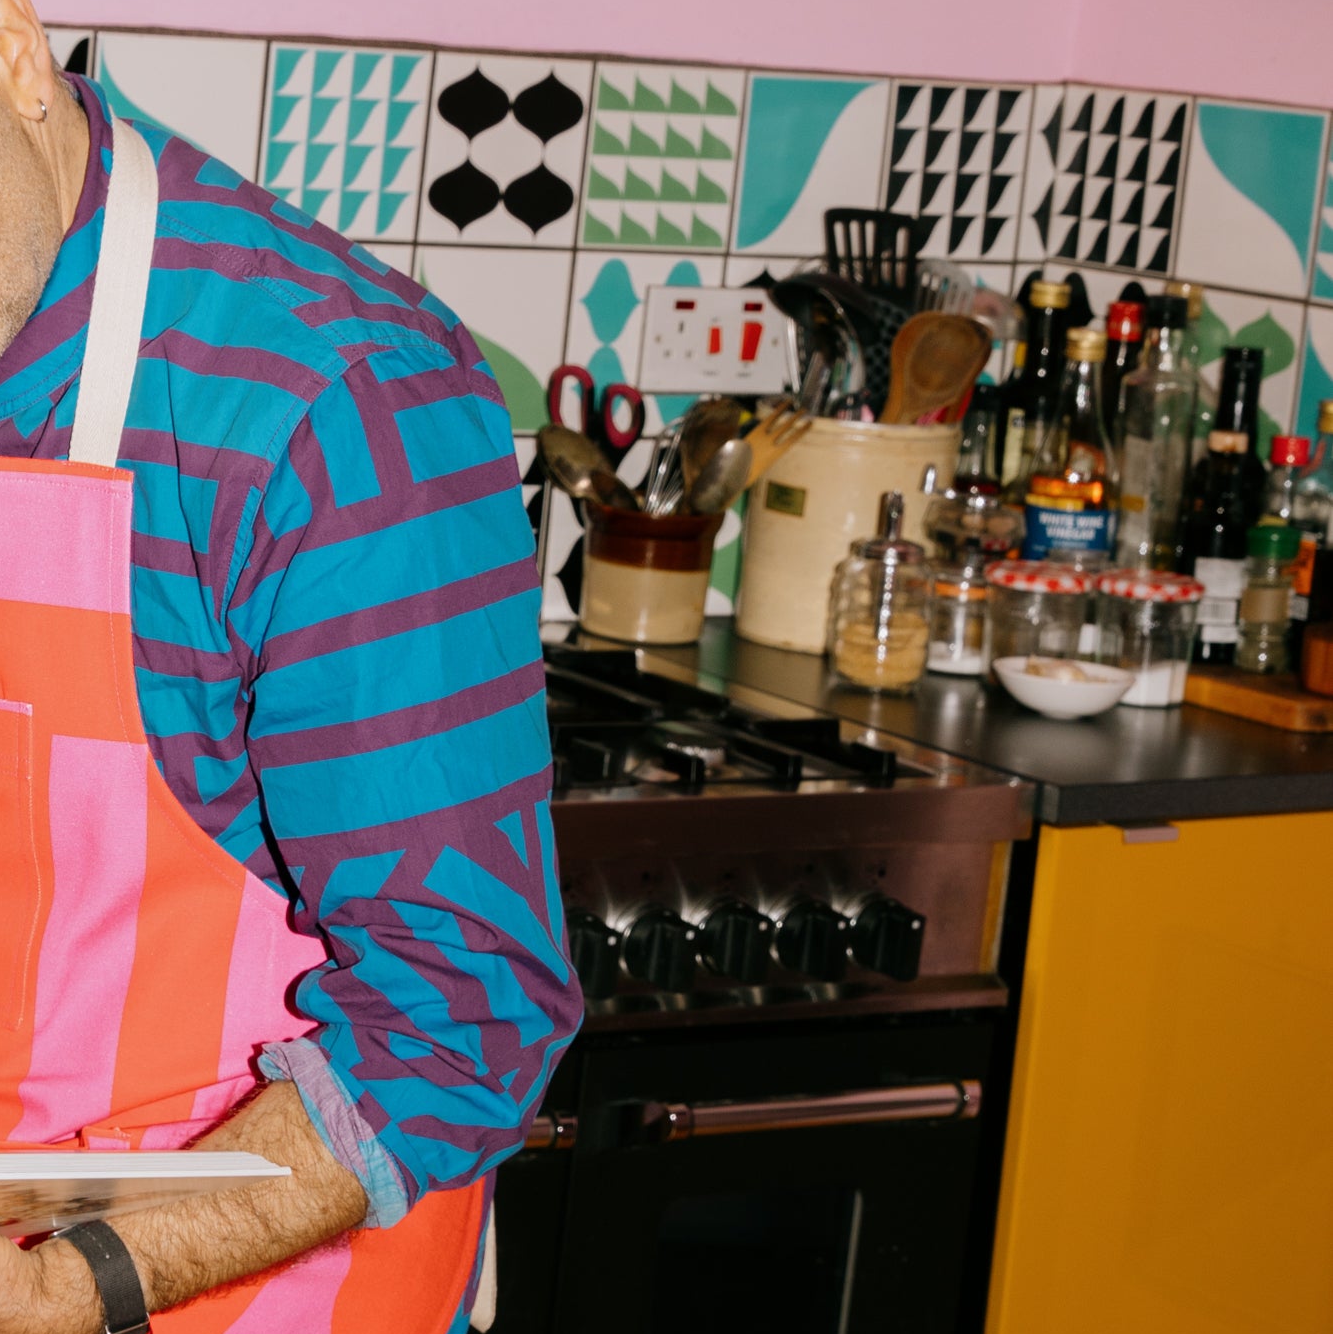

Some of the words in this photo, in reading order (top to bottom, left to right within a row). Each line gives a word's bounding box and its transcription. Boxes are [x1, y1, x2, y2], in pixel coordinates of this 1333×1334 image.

[1039, 512, 1074, 527] WHITE
[1076, 515, 1104, 527] WINE
[1046, 528, 1096, 540] VINEGAR
